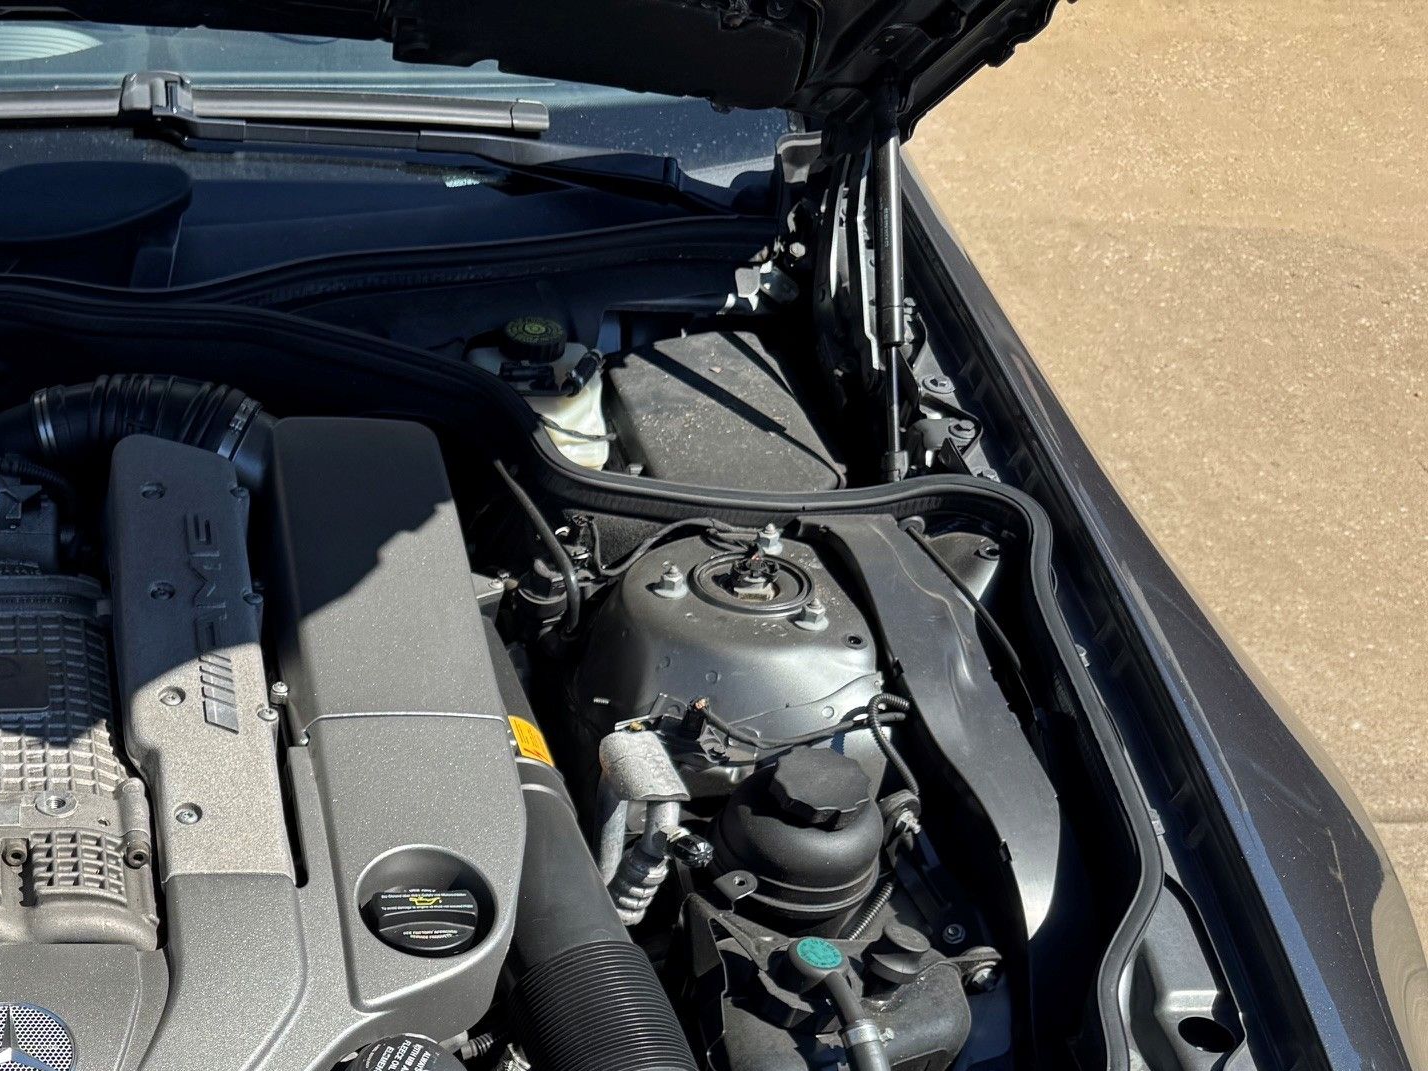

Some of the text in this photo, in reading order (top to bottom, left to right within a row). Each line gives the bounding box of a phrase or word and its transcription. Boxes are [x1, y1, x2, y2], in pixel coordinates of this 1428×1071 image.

[184, 512, 228, 655] AMG
[394, 1040, 412, 1061] FLEECE
[388, 1059, 400, 1071] OIL
